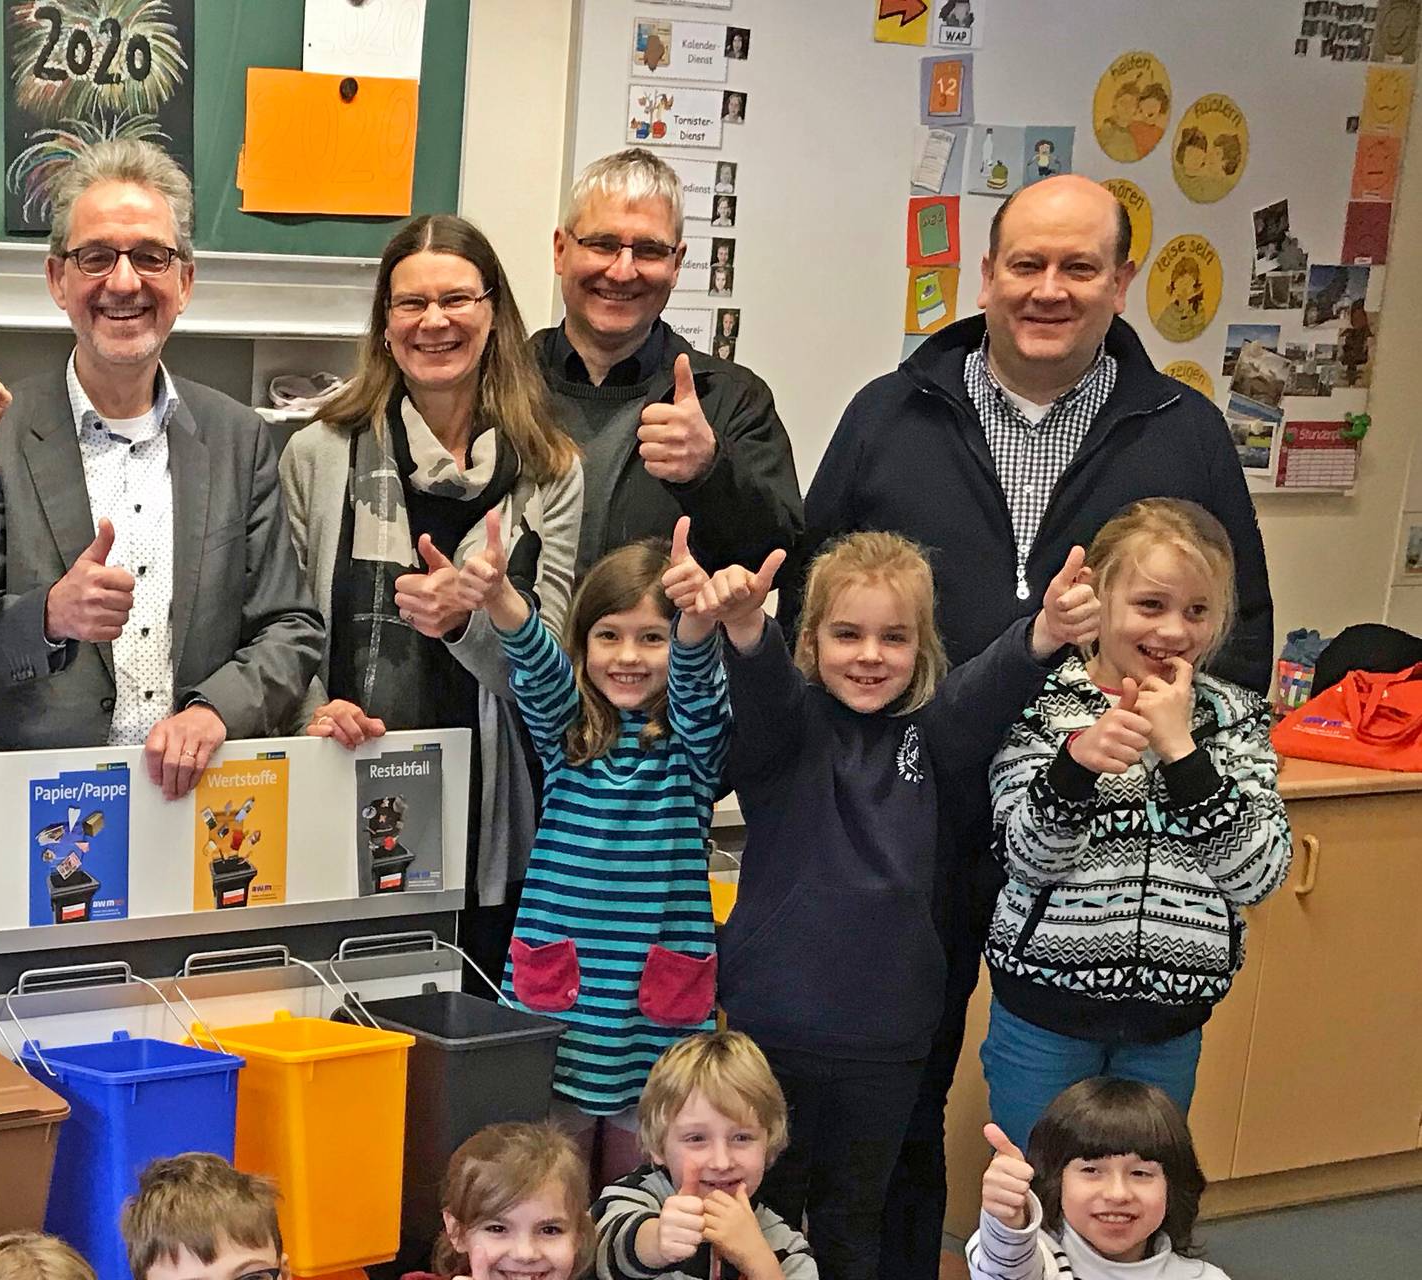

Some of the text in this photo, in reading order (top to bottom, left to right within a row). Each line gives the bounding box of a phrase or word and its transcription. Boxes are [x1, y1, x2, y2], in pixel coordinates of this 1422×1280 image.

[945, 30, 967, 42] WAP
[34, 6, 151, 84] 2020
[688, 54, 713, 65] Dienst
[674, 114, 714, 126] Tornister-
[680, 130, 705, 141] Dienst
[370, 760, 430, 779] Restabfall
[207, 769, 277, 788] Wertstoffe
[35, 782, 127, 804] Papier/Pappe
